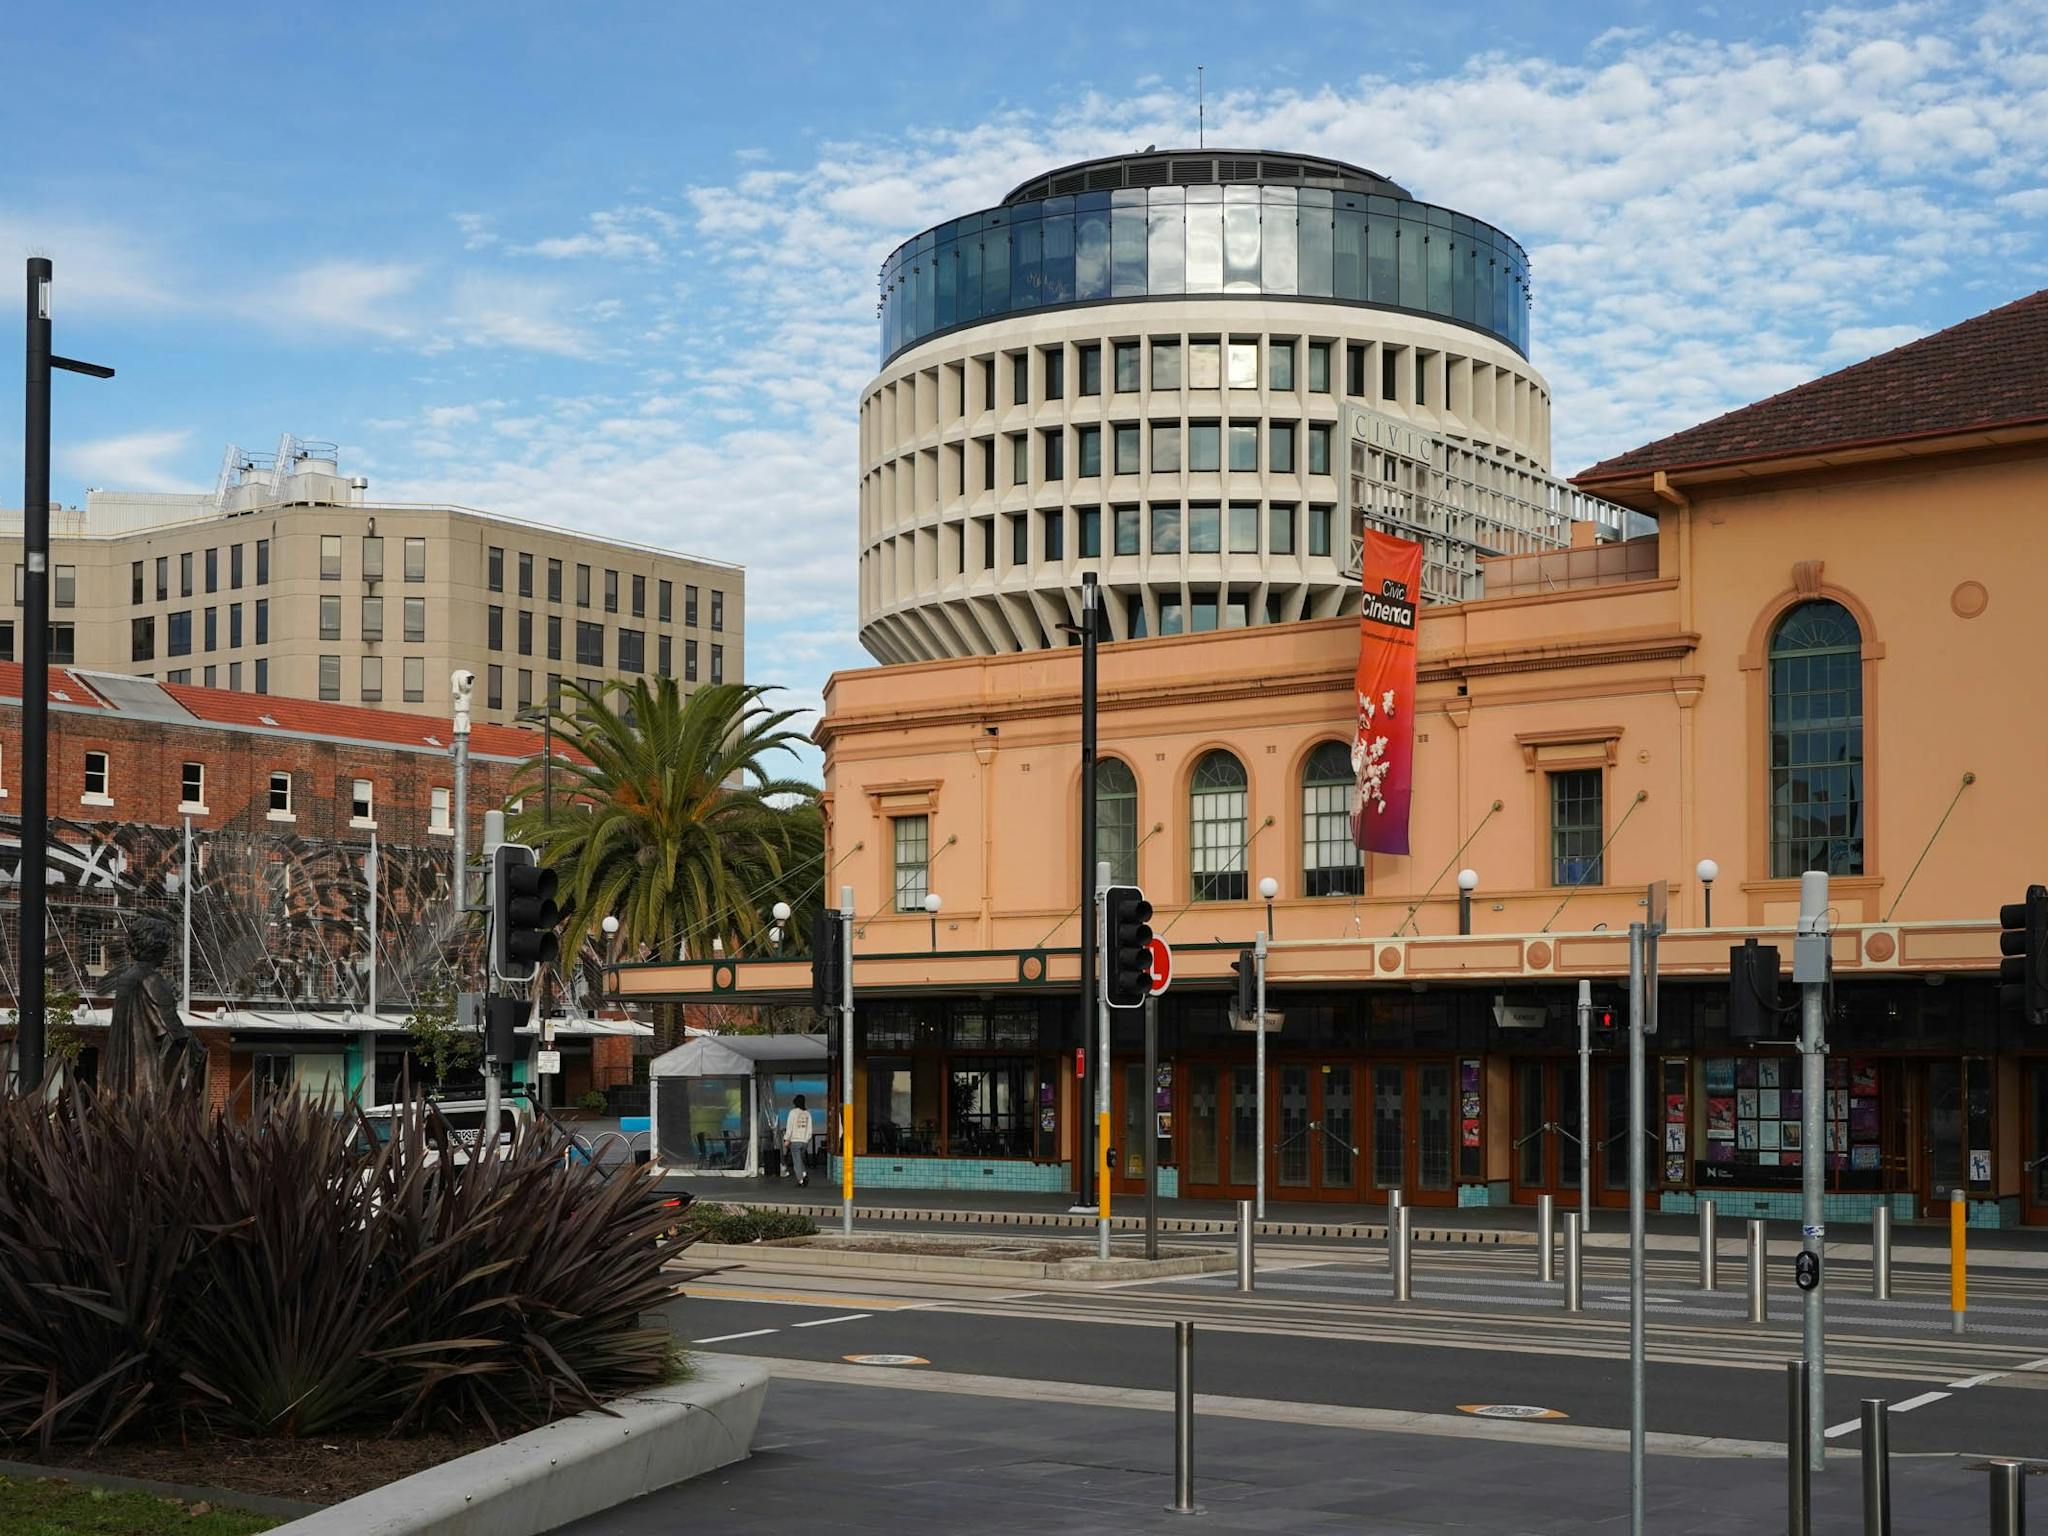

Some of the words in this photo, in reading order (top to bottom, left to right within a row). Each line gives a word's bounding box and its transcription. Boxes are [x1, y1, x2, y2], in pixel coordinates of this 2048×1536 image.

[1356, 415, 1431, 461] CIVIC
[1382, 580, 1406, 601] Civic
[1362, 593, 1412, 626] Cinema
